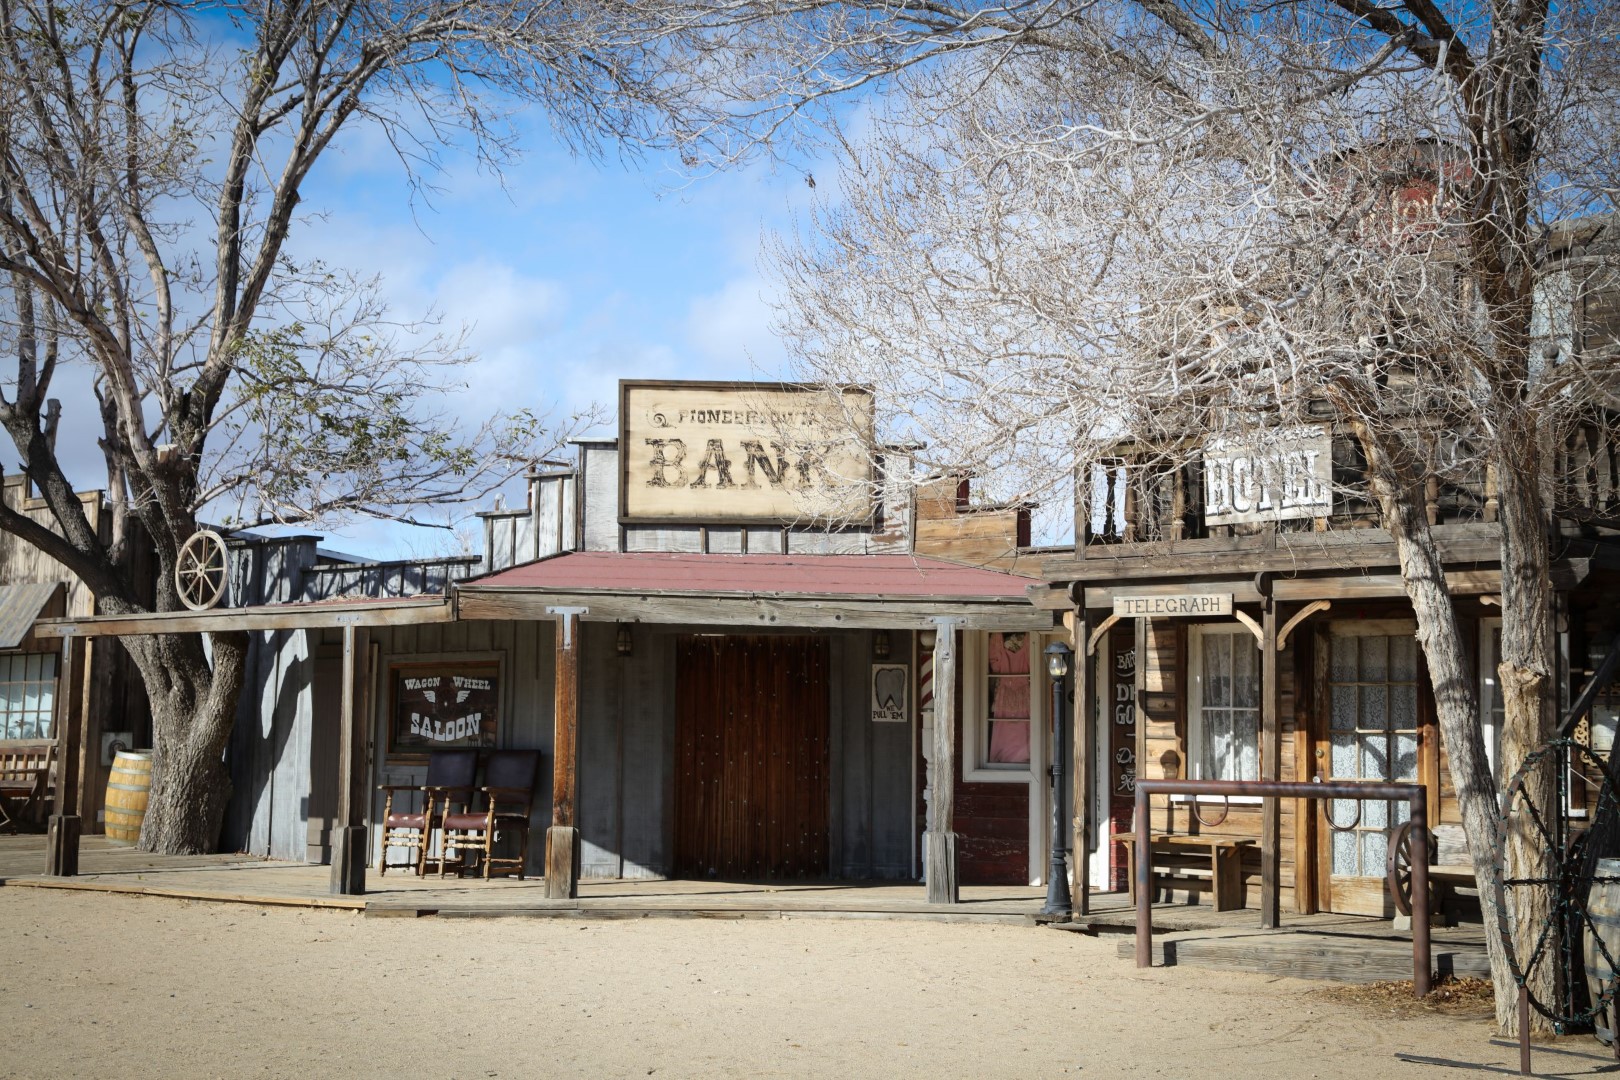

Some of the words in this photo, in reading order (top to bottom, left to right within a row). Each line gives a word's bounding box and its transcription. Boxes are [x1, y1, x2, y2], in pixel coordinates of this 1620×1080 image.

[645, 438, 846, 489] BANK
[1124, 597, 1220, 613] TELEGRAPH
[405, 677, 441, 690] WAGON
[453, 676, 490, 690] WHEEL
[872, 711, 887, 719] PULL
[411, 713, 481, 742] SALOON
